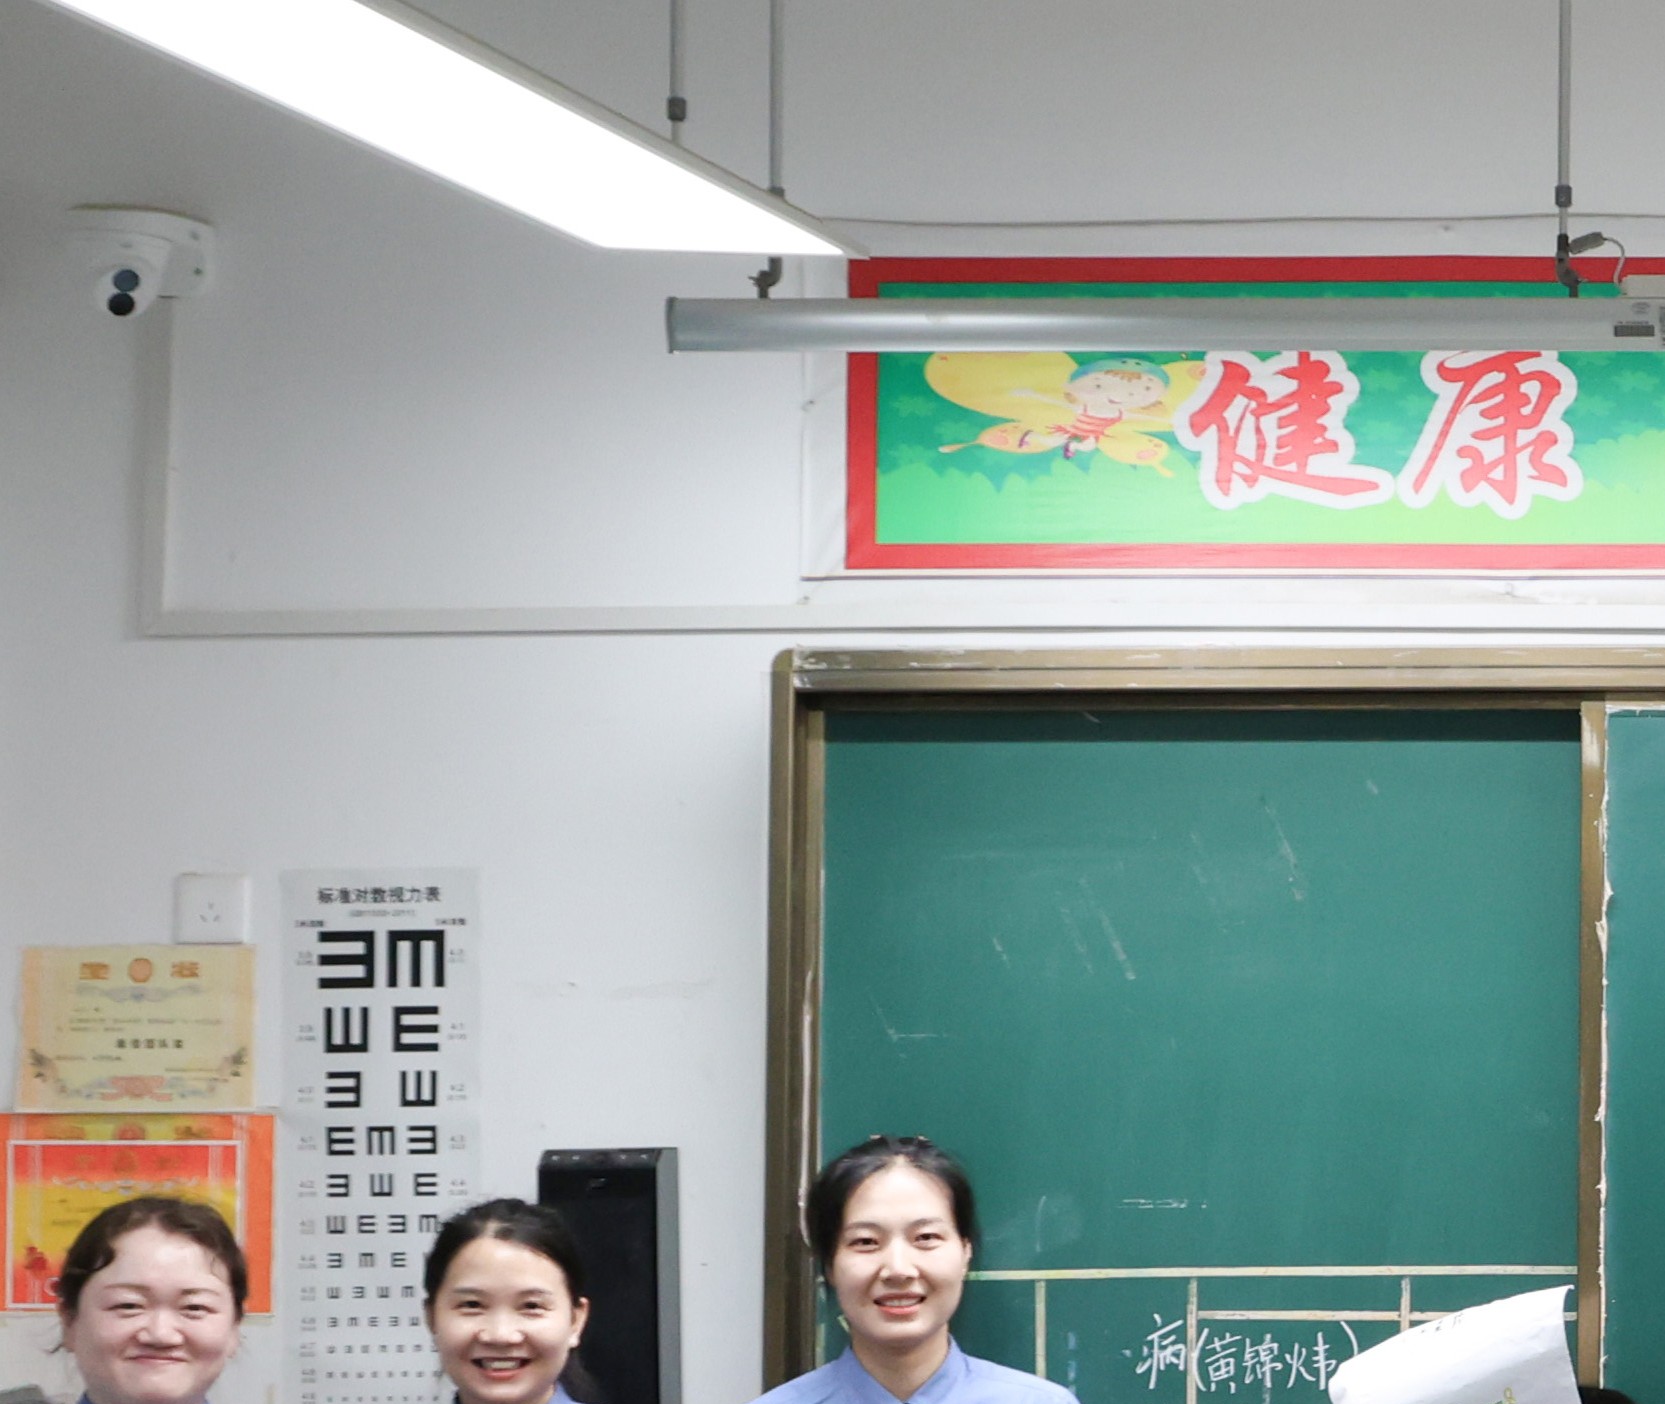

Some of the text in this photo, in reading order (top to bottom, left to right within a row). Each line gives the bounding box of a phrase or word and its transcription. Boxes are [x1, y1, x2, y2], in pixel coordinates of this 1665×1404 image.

[1202, 346, 1571, 500] 健康
[318, 886, 441, 904] 标准对数视力表
